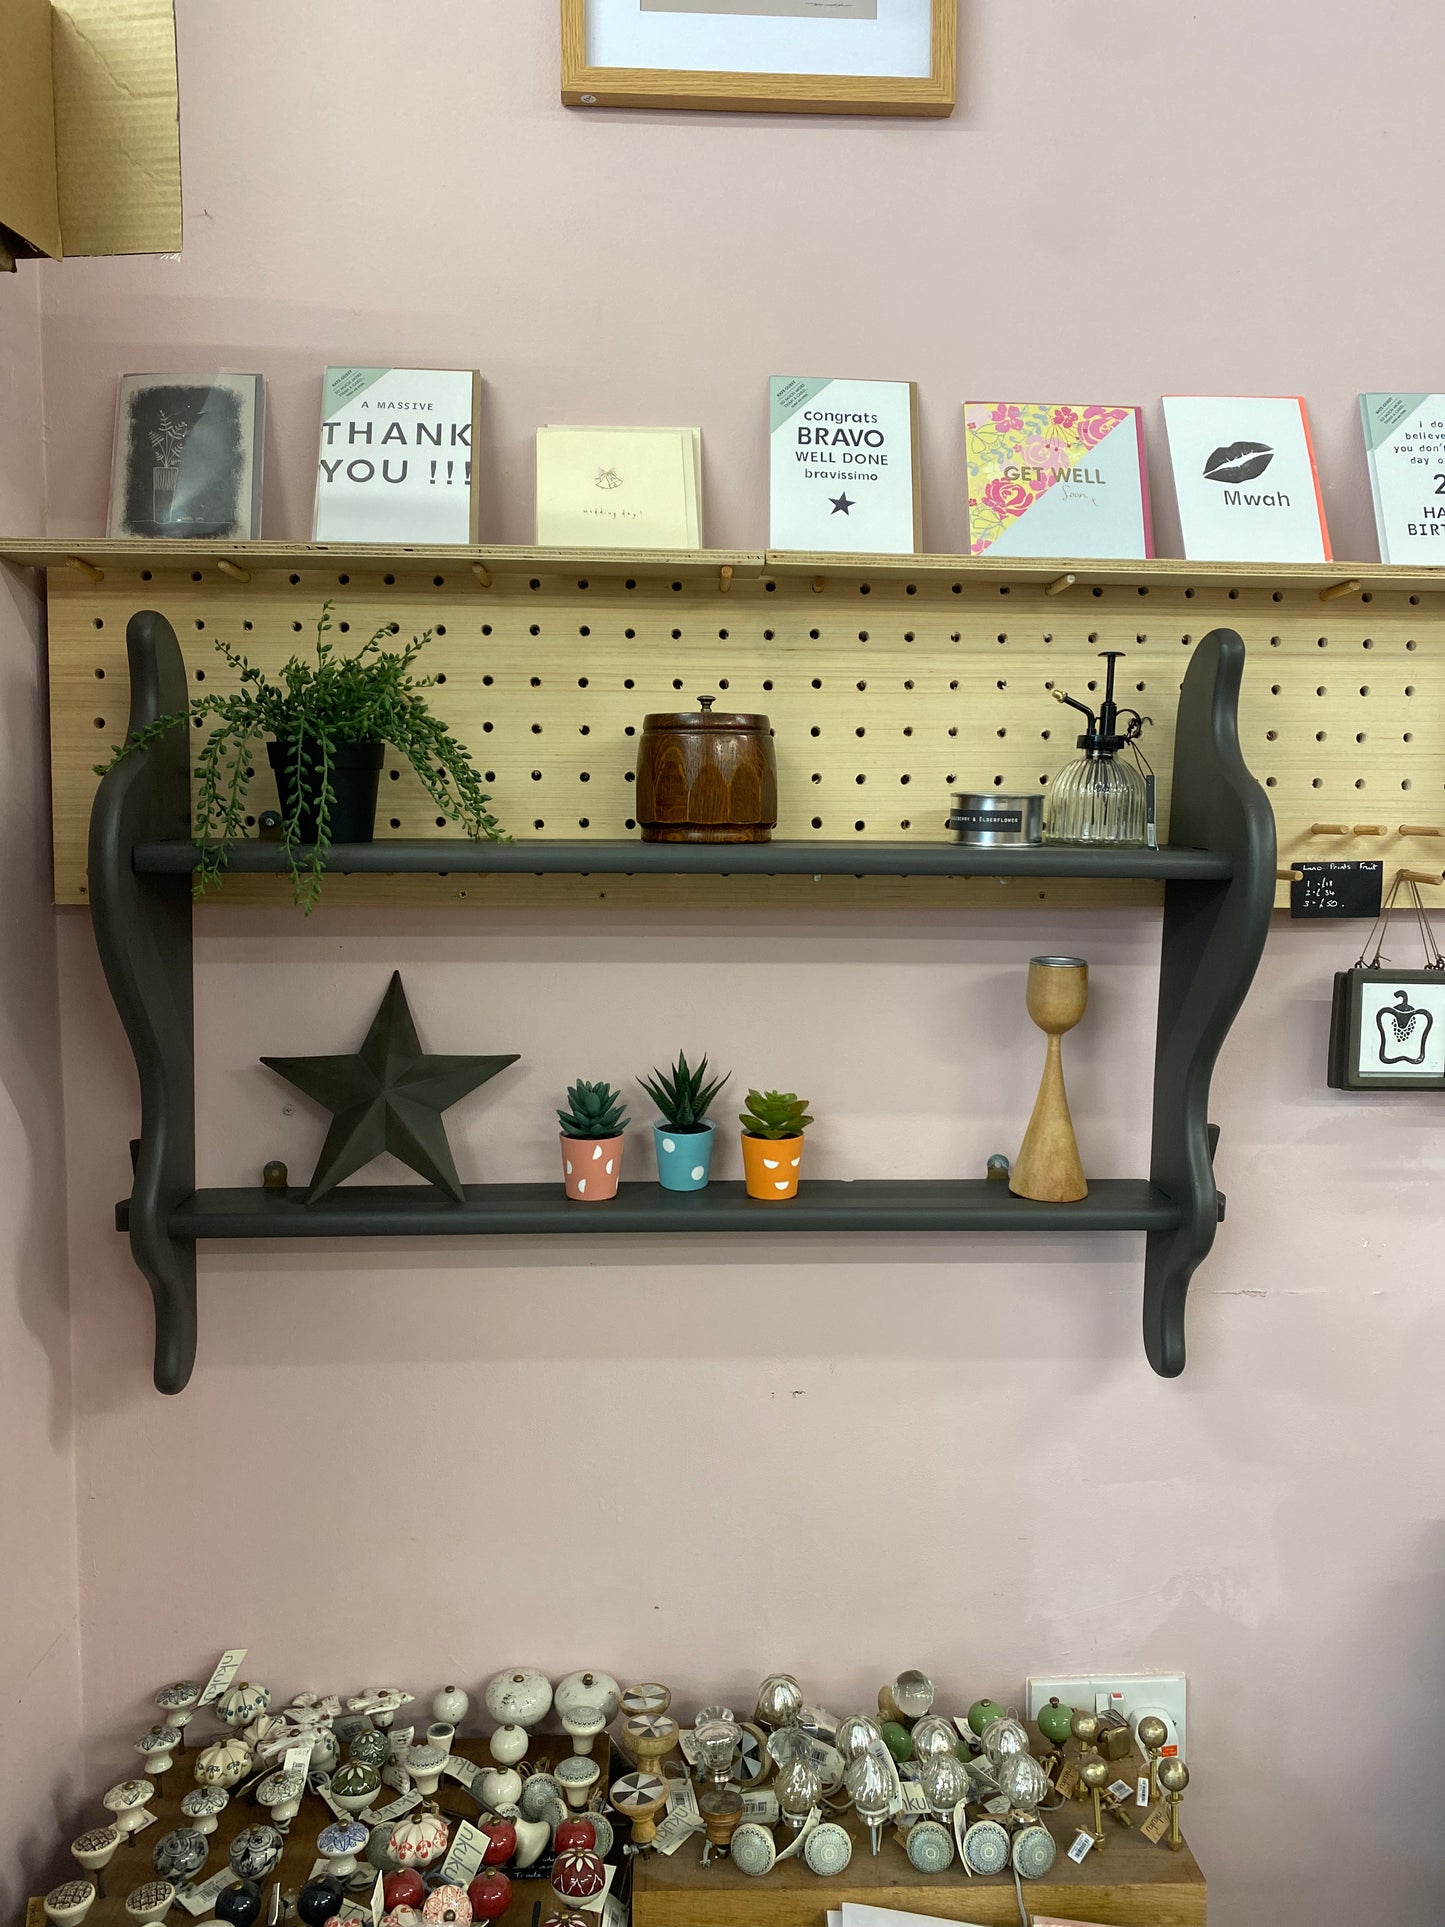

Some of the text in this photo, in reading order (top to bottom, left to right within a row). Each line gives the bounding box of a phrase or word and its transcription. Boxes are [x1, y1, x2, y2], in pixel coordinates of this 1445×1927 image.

[361, 401, 433, 411] A MASSIVE
[804, 411, 878, 424] congrats
[322, 421, 472, 446] THANK
[798, 427, 884, 448] BRAVO
[1393, 445, 1413, 454] you
[795, 451, 888, 466] WELL DONE
[1410, 456, 1429, 465] day
[320, 458, 408, 484] YOU
[805, 468, 878, 481] bravissimo
[1004, 466, 1106, 484] GET WELL
[1062, 484, 1087, 501] Soon
[1223, 490, 1290, 507] Mwah
[203, 1655, 239, 1701] nkuku
[443, 1826, 483, 1884] nkuku
